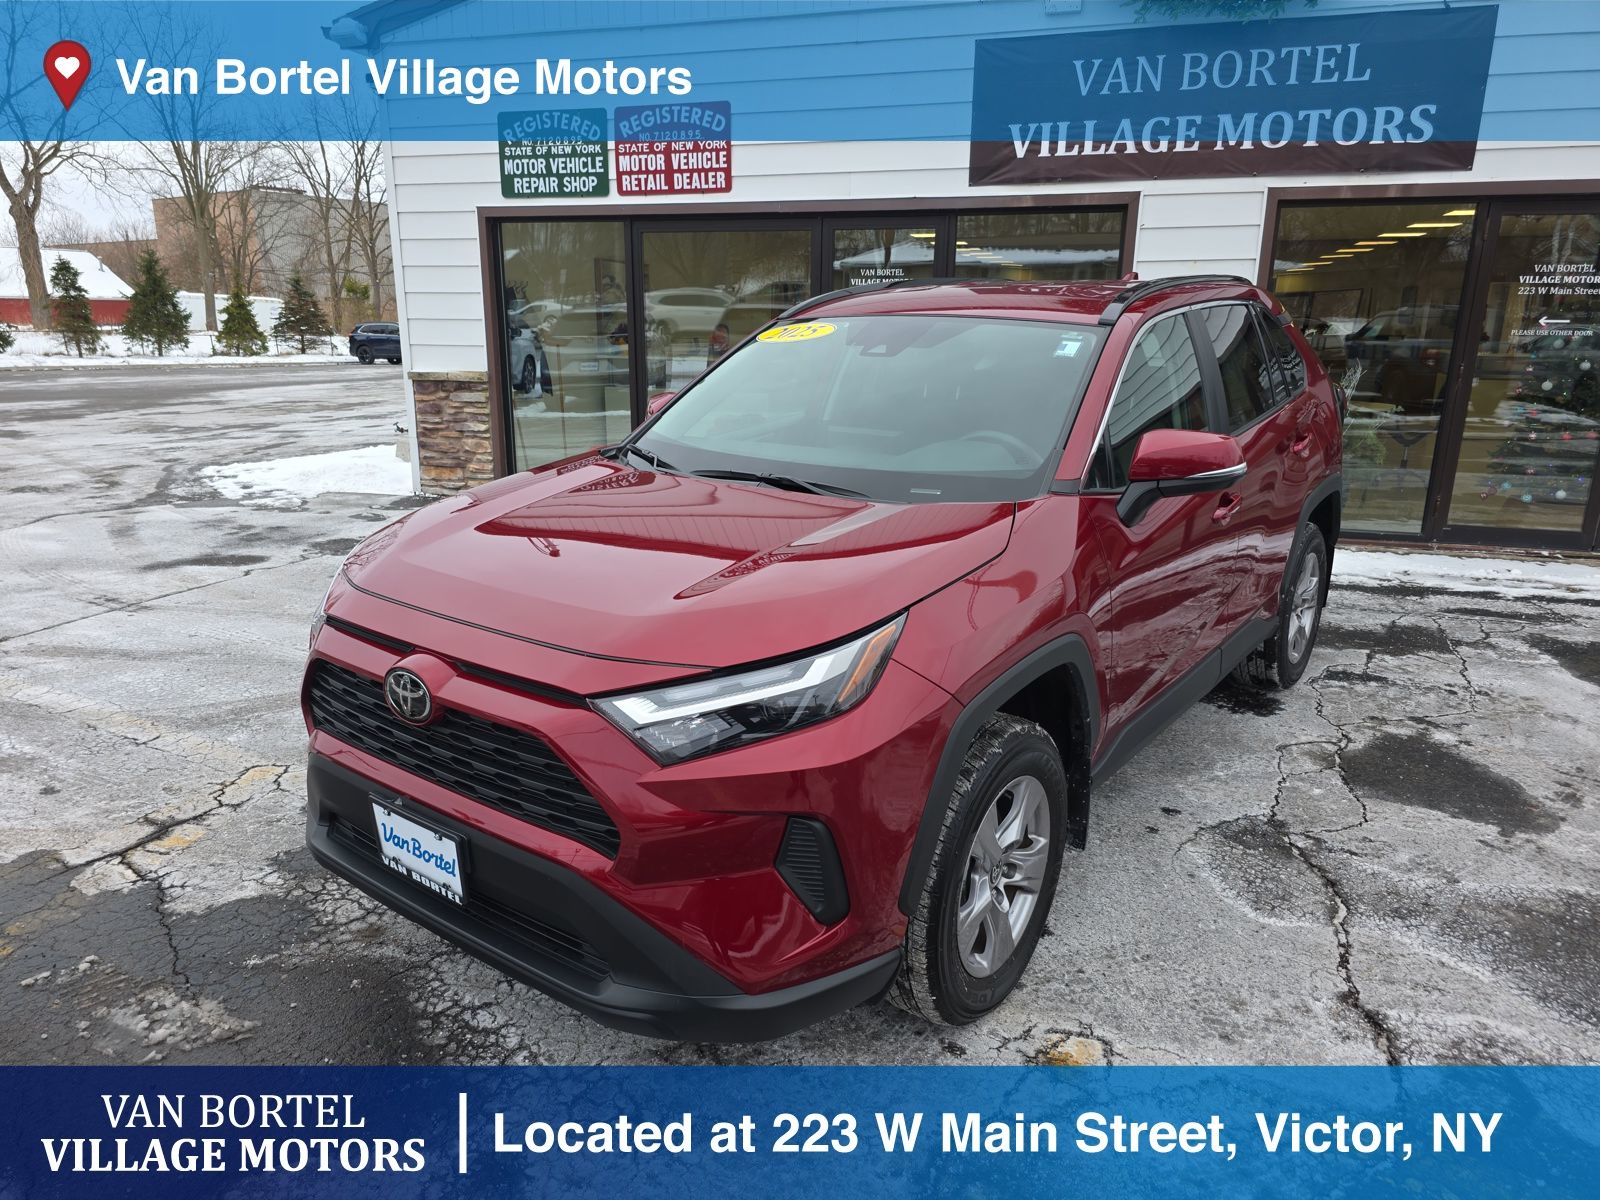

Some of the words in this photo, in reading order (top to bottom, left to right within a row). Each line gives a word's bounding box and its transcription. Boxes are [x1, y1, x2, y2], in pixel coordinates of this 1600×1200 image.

[1073, 54, 1166, 97] VAN
[1180, 43, 1371, 91] BORTEL
[503, 111, 601, 145] REGISTERED
[619, 105, 726, 138] REGISTERED
[1008, 115, 1203, 159] VILLAGE
[1213, 104, 1437, 151] MOTORS
[504, 147, 533, 156] STATE
[535, 146, 548, 155] OF
[551, 145, 572, 154] NEW
[575, 144, 602, 154] YORK
[618, 143, 650, 153] STATE
[653, 142, 667, 151] OF
[671, 141, 694, 151] NEW
[698, 140, 727, 150] YORK
[504, 158, 546, 175] MOTOR
[549, 156, 604, 174] VEHICLE
[618, 154, 665, 172] MOTOR
[671, 151, 728, 170] VEHICLE
[514, 177, 559, 193] REPAIR
[563, 175, 598, 193] SHOP
[622, 173, 669, 191] RETAIL
[673, 171, 726, 190] DEALER
[860, 268, 875, 276] VAN
[876, 268, 905, 276] BORTEL
[1534, 264, 1555, 273] VAN
[1556, 263, 1596, 273] BORTEL
[1519, 275, 1562, 284] VILLAGE
[1517, 286, 1535, 295] 223
[1537, 286, 1548, 295] W
[1549, 286, 1572, 295] Main
[381, 854, 408, 876] VAN
[411, 871, 463, 906] BORTEL
